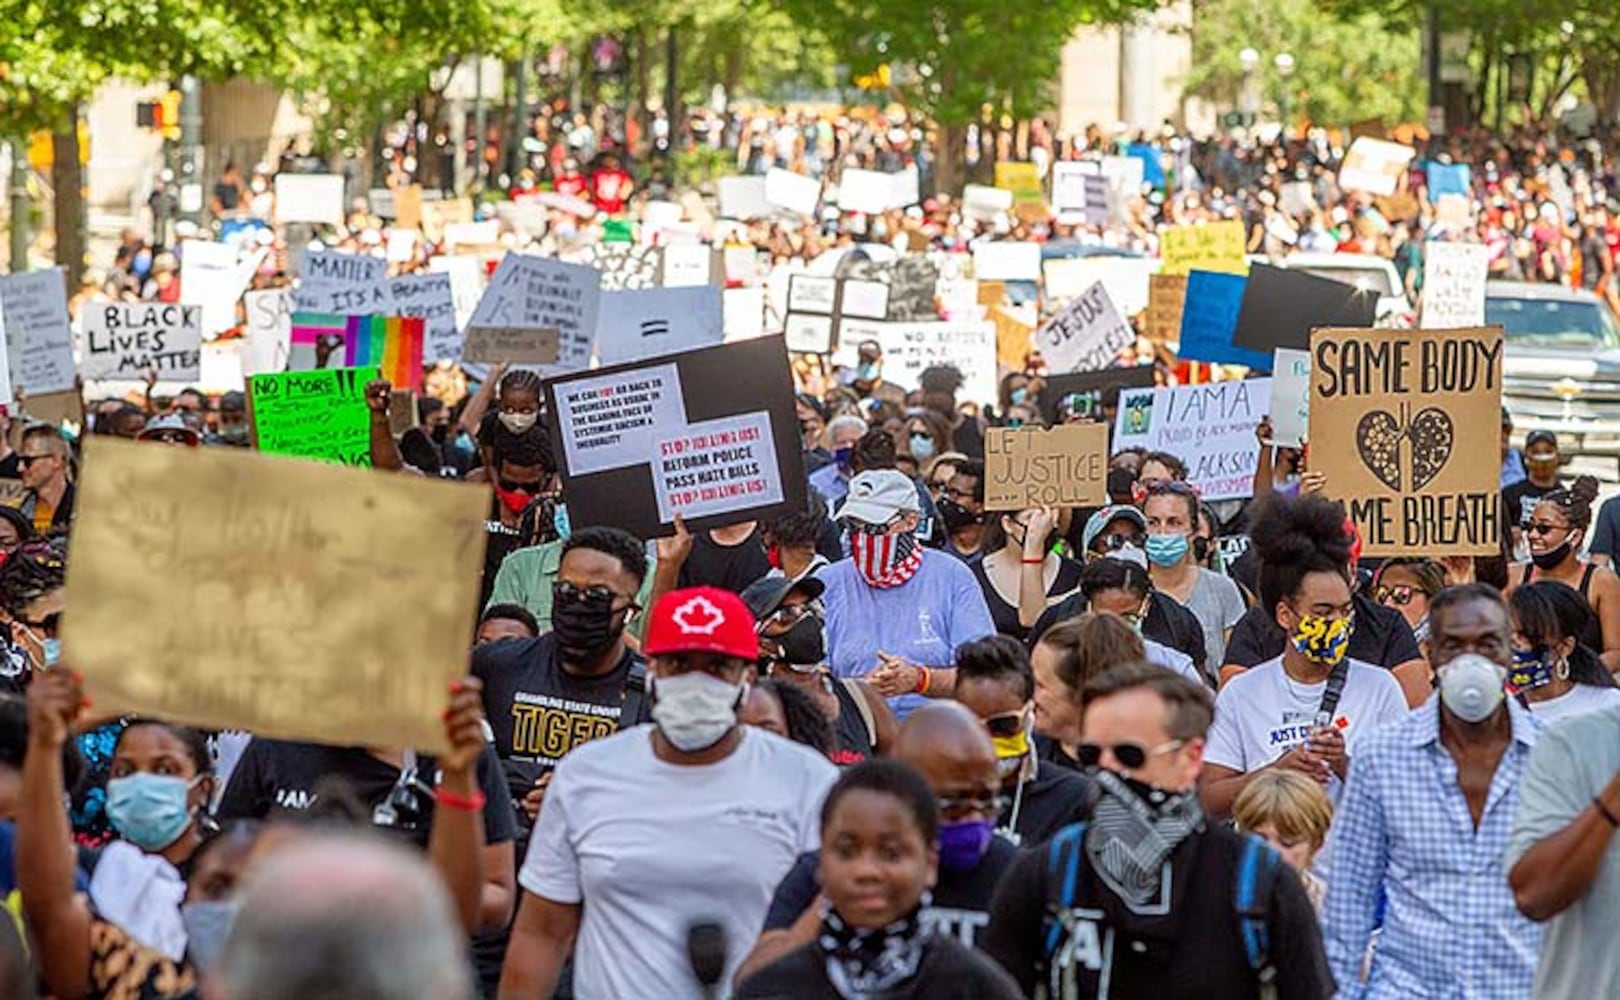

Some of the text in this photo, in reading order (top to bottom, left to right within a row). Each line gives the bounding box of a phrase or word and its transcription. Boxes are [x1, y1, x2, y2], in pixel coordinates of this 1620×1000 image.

[104, 306, 195, 329] BLACK
[1047, 287, 1104, 346] JESUS
[119, 350, 200, 372] MATTER
[1317, 339, 1411, 398] SAME
[1421, 339, 1502, 395] BODY
[255, 379, 279, 396] NO
[628, 380, 650, 392] BACK
[570, 399, 610, 415] BUSINESS
[623, 406, 642, 419] FACE
[1166, 391, 1176, 423] I
[574, 422, 613, 438] SYSTEMIC
[615, 417, 646, 431] RACISM
[576, 434, 621, 450] INEQUALITY
[661, 438, 690, 456] STOP
[693, 431, 737, 450] KILLING
[988, 430, 1036, 455] LET
[663, 445, 753, 473] REFORM POLICE
[994, 453, 1101, 485] JUSTICE
[665, 462, 761, 491] PASS HATE BILLS
[669, 491, 698, 507] STOP
[700, 483, 746, 502] KILLING
[1025, 484, 1089, 506] ROLL
[1403, 495, 1500, 547] BREATH
[1270, 726, 1297, 745] JUST
